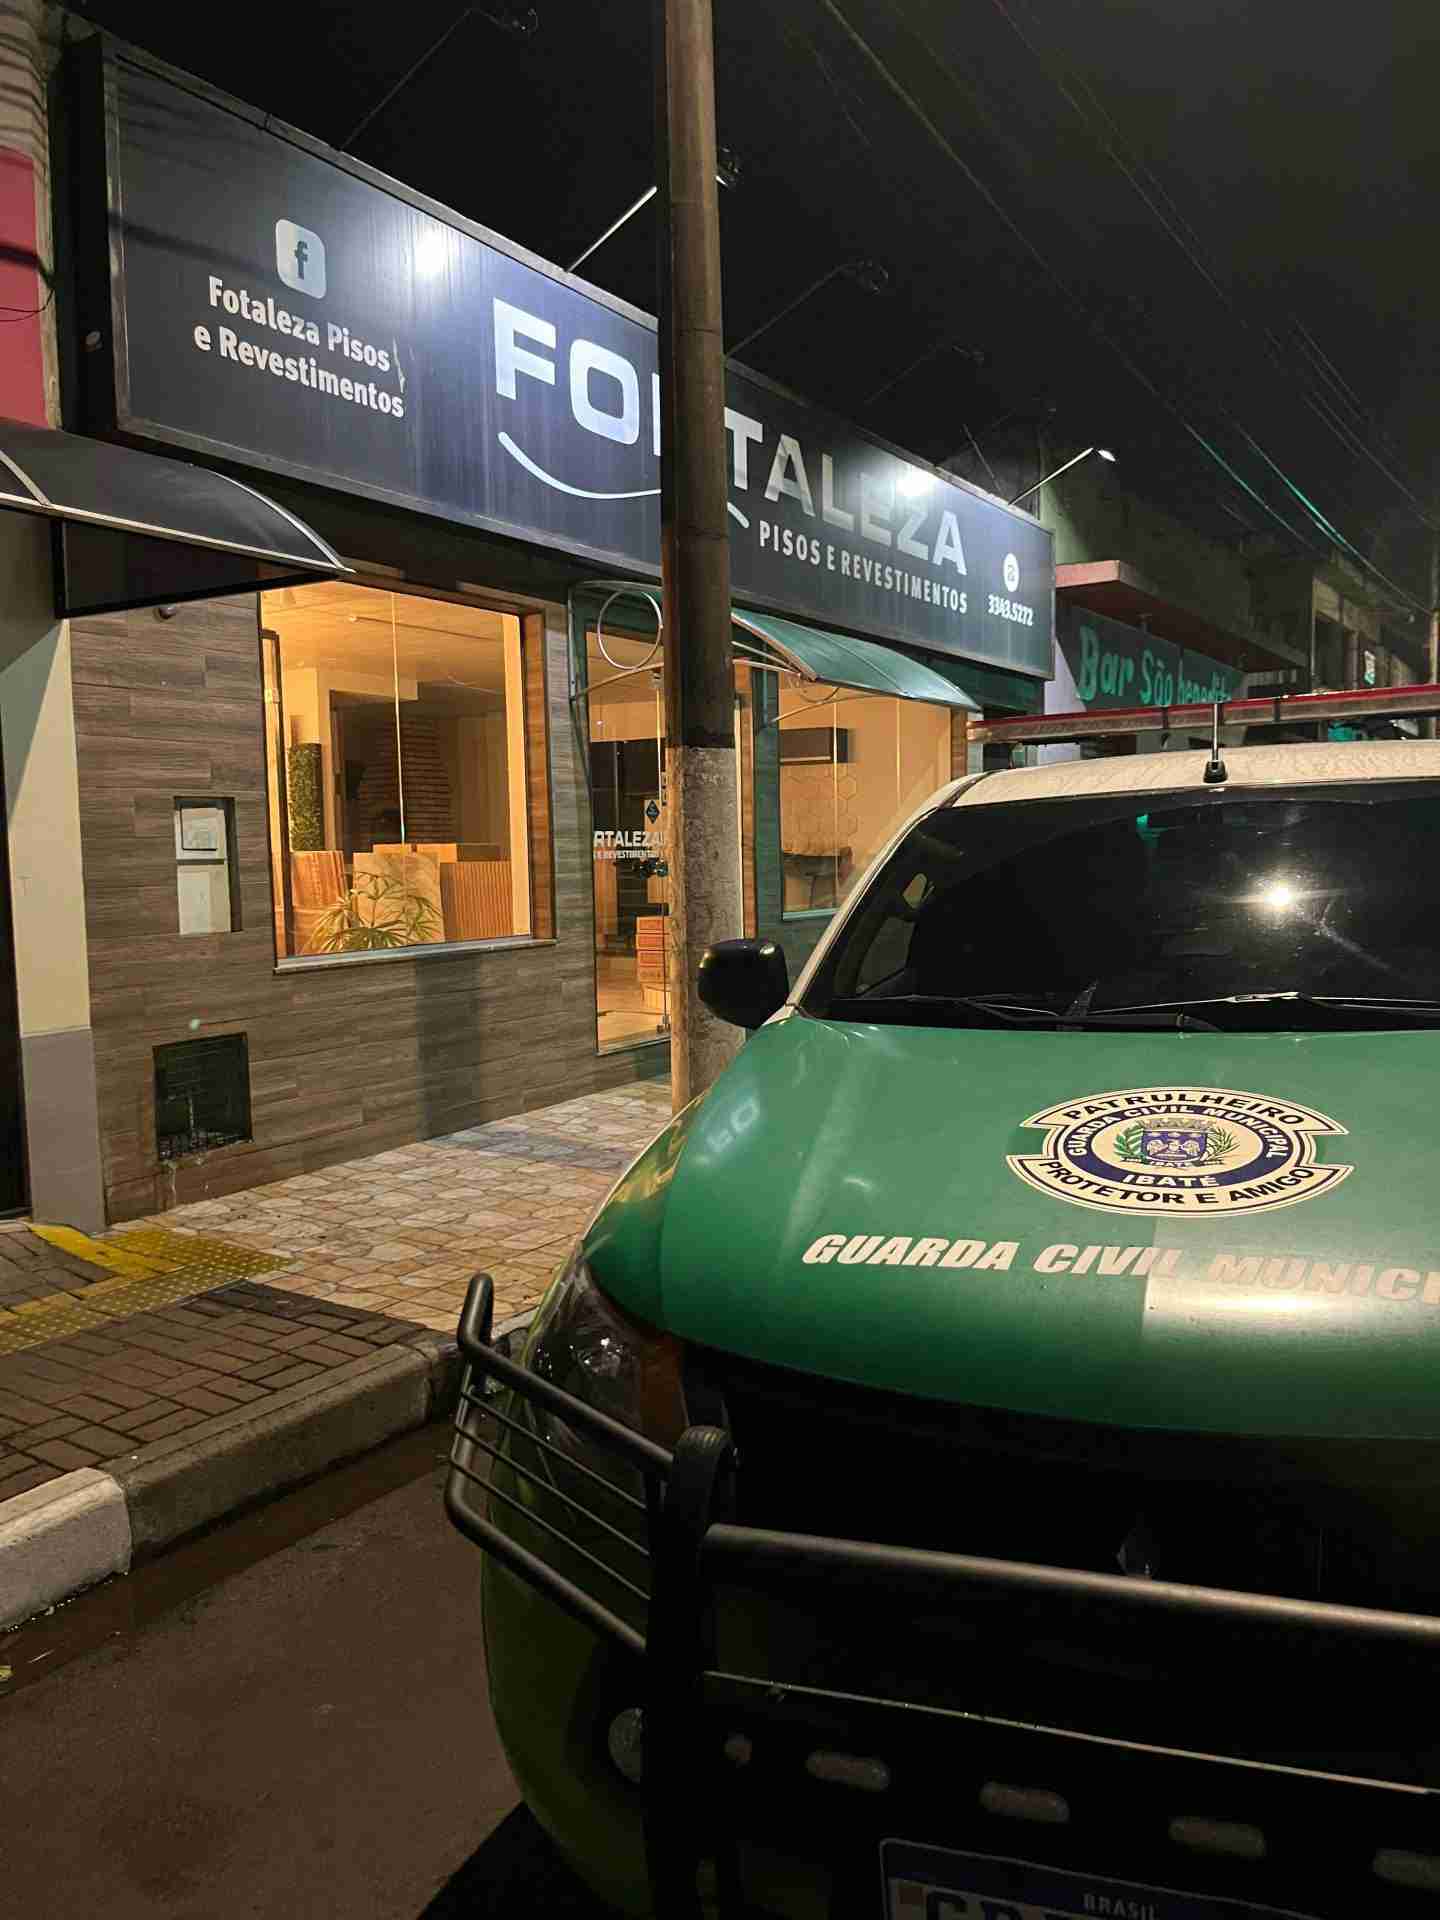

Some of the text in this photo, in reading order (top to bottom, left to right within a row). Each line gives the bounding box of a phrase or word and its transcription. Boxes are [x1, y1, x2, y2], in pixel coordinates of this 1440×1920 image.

[208, 275, 390, 372] Fotaleza Pisos
[194, 325, 405, 418] e Revestimentos
[493, 297, 968, 577] FOTALEZA
[759, 520, 968, 614] PISOS E REVESTIMENTOS
[1075, 625, 1135, 701] Bar
[1139, 650, 1174, 708] São
[1062, 1093, 1305, 1125] PATRULHEIRO
[1067, 1104, 1290, 1159] GUARDA CIVIL MUNICIPAL
[1039, 1160, 1316, 1205] PROTETOR E AMIGO
[1122, 1174, 1220, 1188] IBATÉ
[801, 1233, 1021, 1271] GUARDA
[1032, 1243, 1183, 1280] CIVIL
